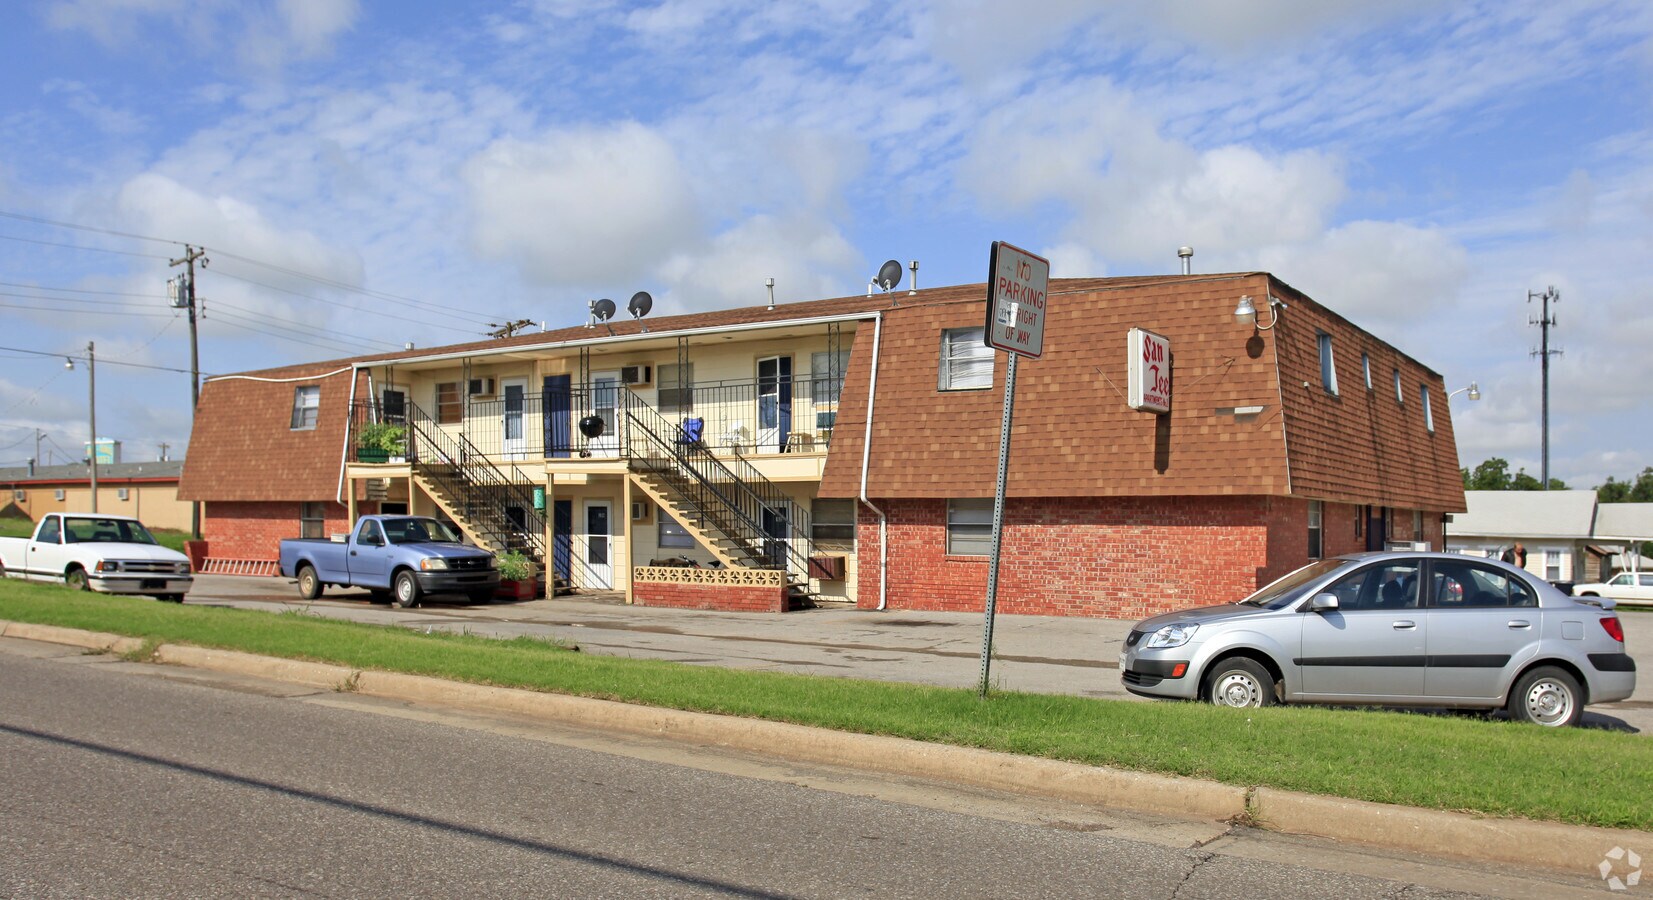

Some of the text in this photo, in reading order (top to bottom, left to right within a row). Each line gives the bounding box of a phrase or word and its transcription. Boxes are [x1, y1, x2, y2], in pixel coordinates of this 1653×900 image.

[1016, 259, 1031, 281] NO
[999, 277, 1043, 309] PARKING
[1017, 307, 1037, 327] RIGHT
[1005, 326, 1031, 346] OF WAY
[1143, 335, 1163, 363] San
